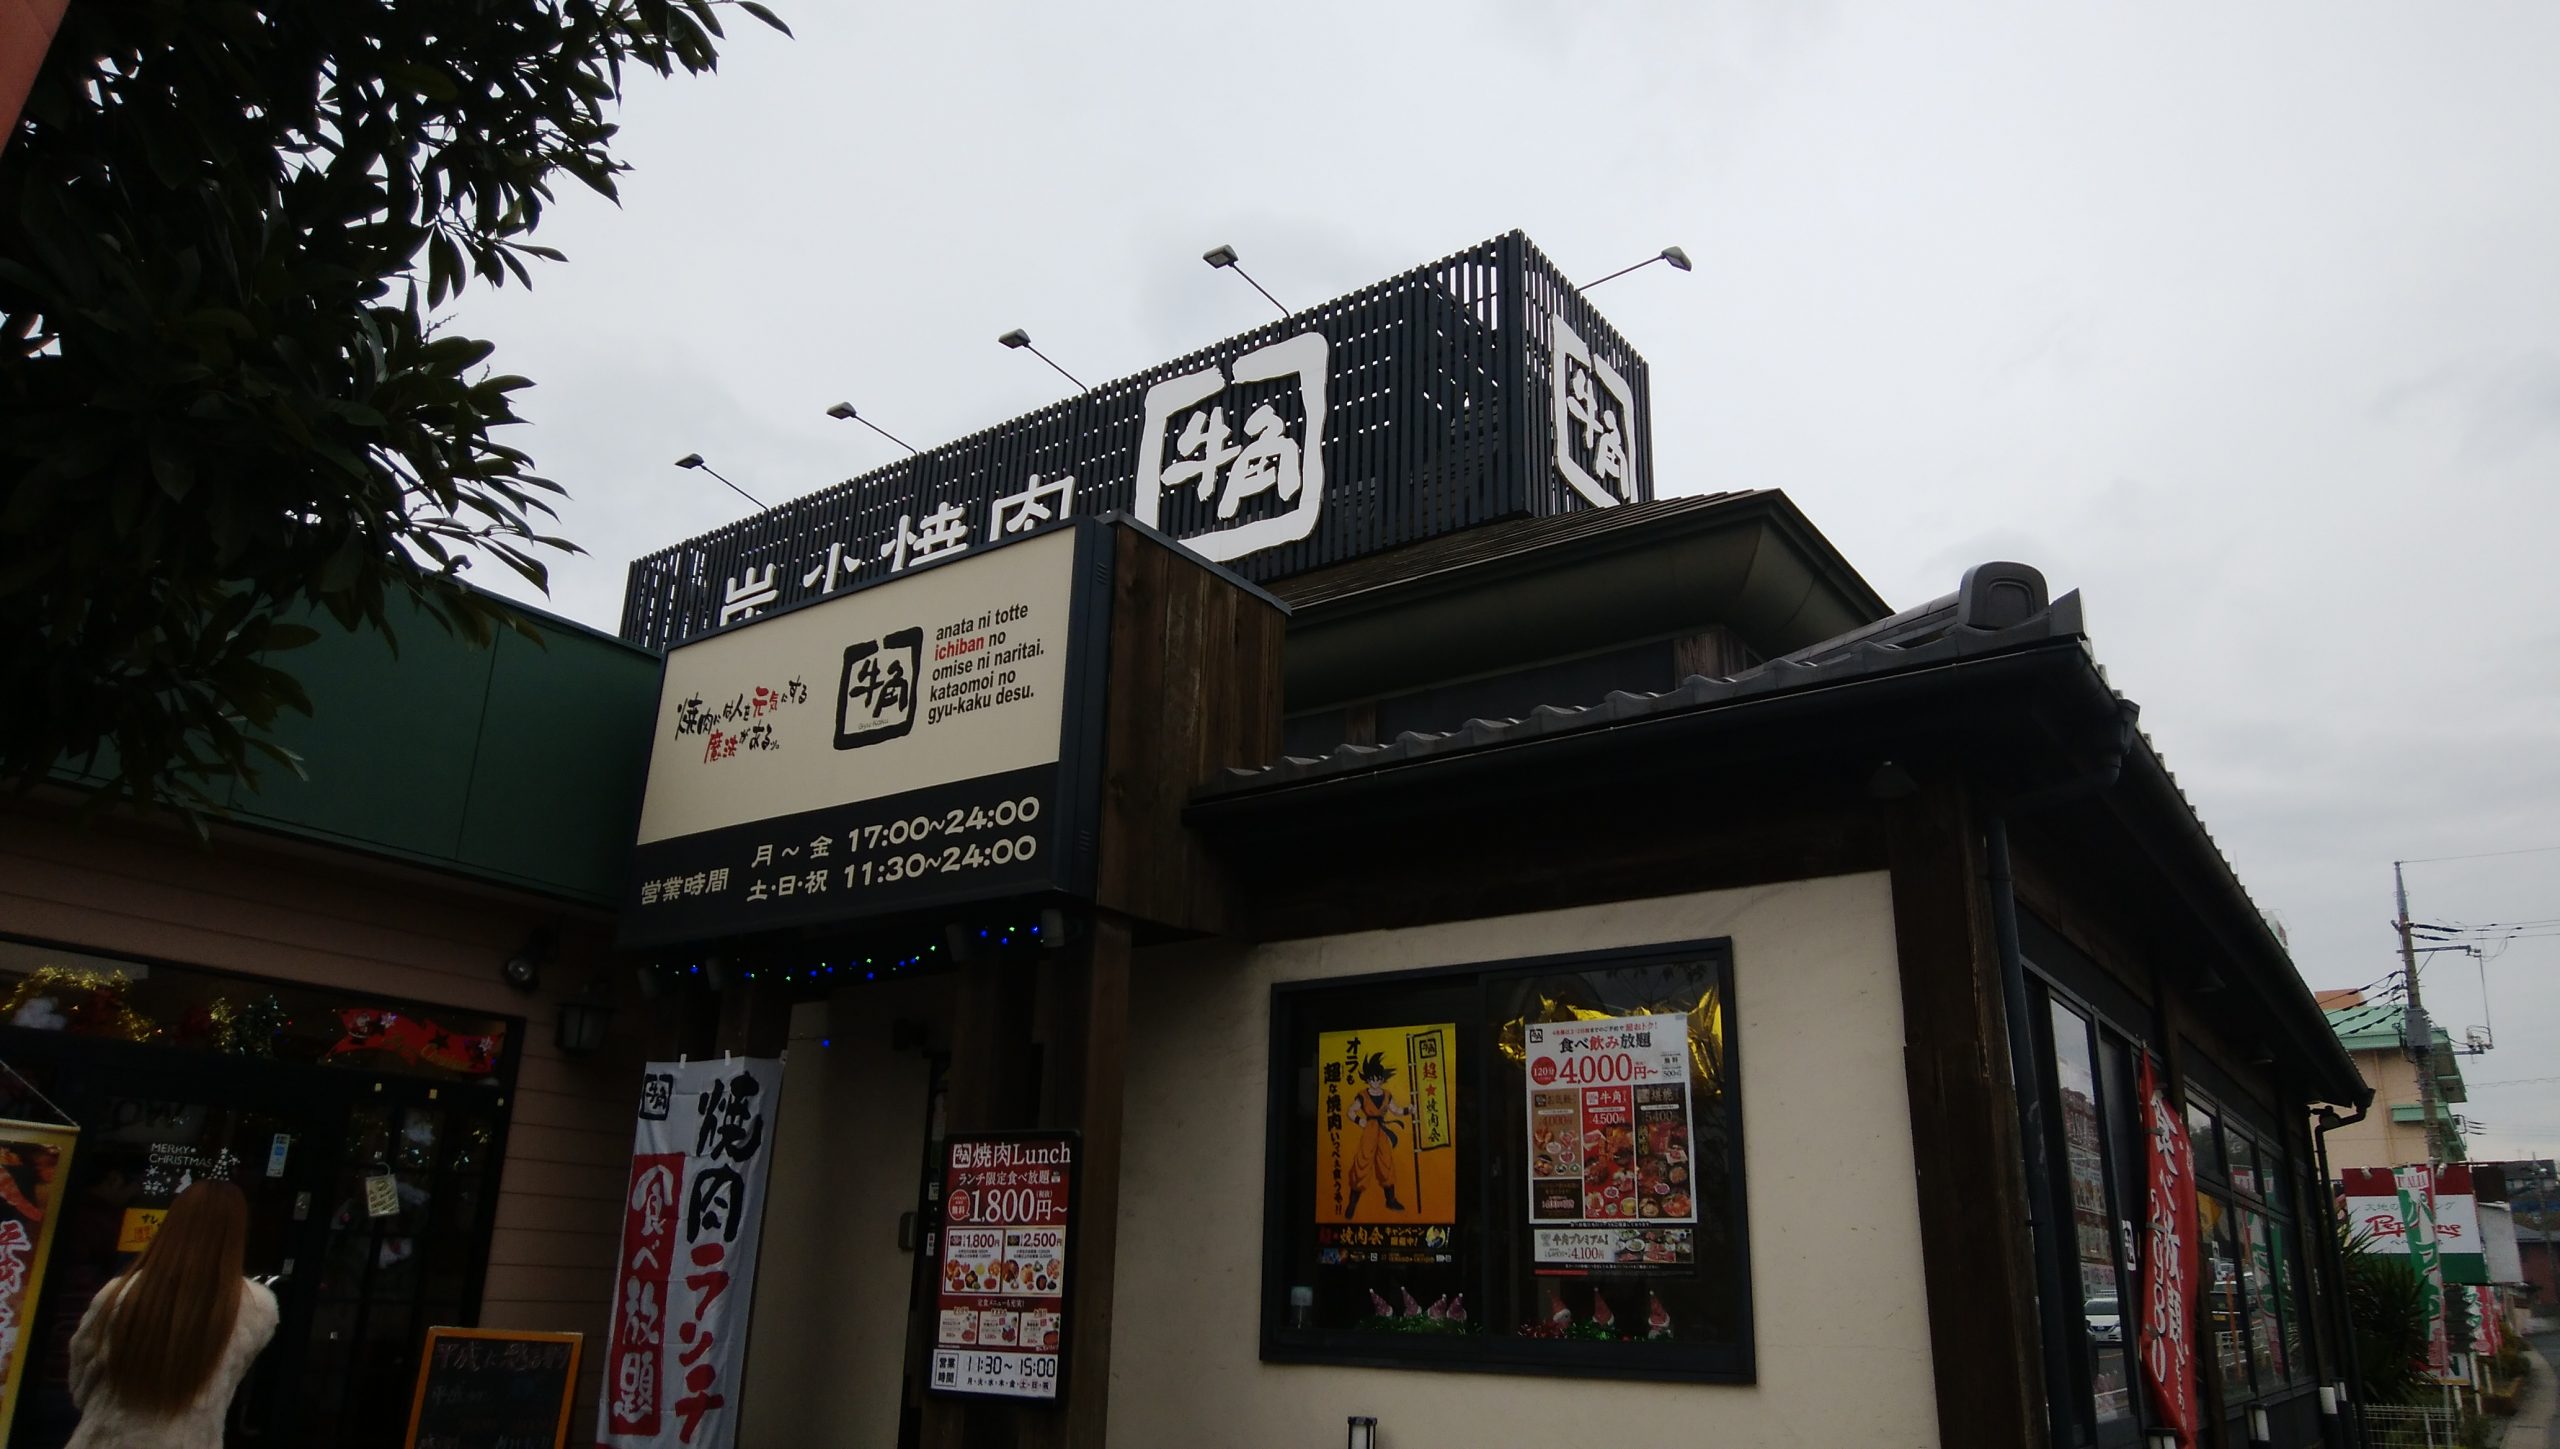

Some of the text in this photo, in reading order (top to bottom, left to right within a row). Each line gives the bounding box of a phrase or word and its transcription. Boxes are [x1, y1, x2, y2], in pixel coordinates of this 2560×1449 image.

[935, 602, 1029, 641] anata ni totte
[932, 638, 1045, 682] omise ni naritai.
[933, 630, 1007, 662] ichiban no
[929, 669, 1016, 702] kataomoi no
[927, 683, 1035, 726] gyu-kaku desu.
[640, 867, 730, 906] 営業時間
[1559, 1031, 1653, 1054] 食べ飲み放題
[1345, 1037, 1361, 1086] オラも
[1600, 1090, 1622, 1104] 牛角
[148, 1154, 213, 1169] CHRISTMAS
[150, 1142, 191, 1155] MERRY
[972, 1142, 1072, 1169] 焼肉Lunch
[959, 1169, 1050, 1187] ランチ限定食べ放題
[675, 1070, 764, 1445] 焼肉ランチ
